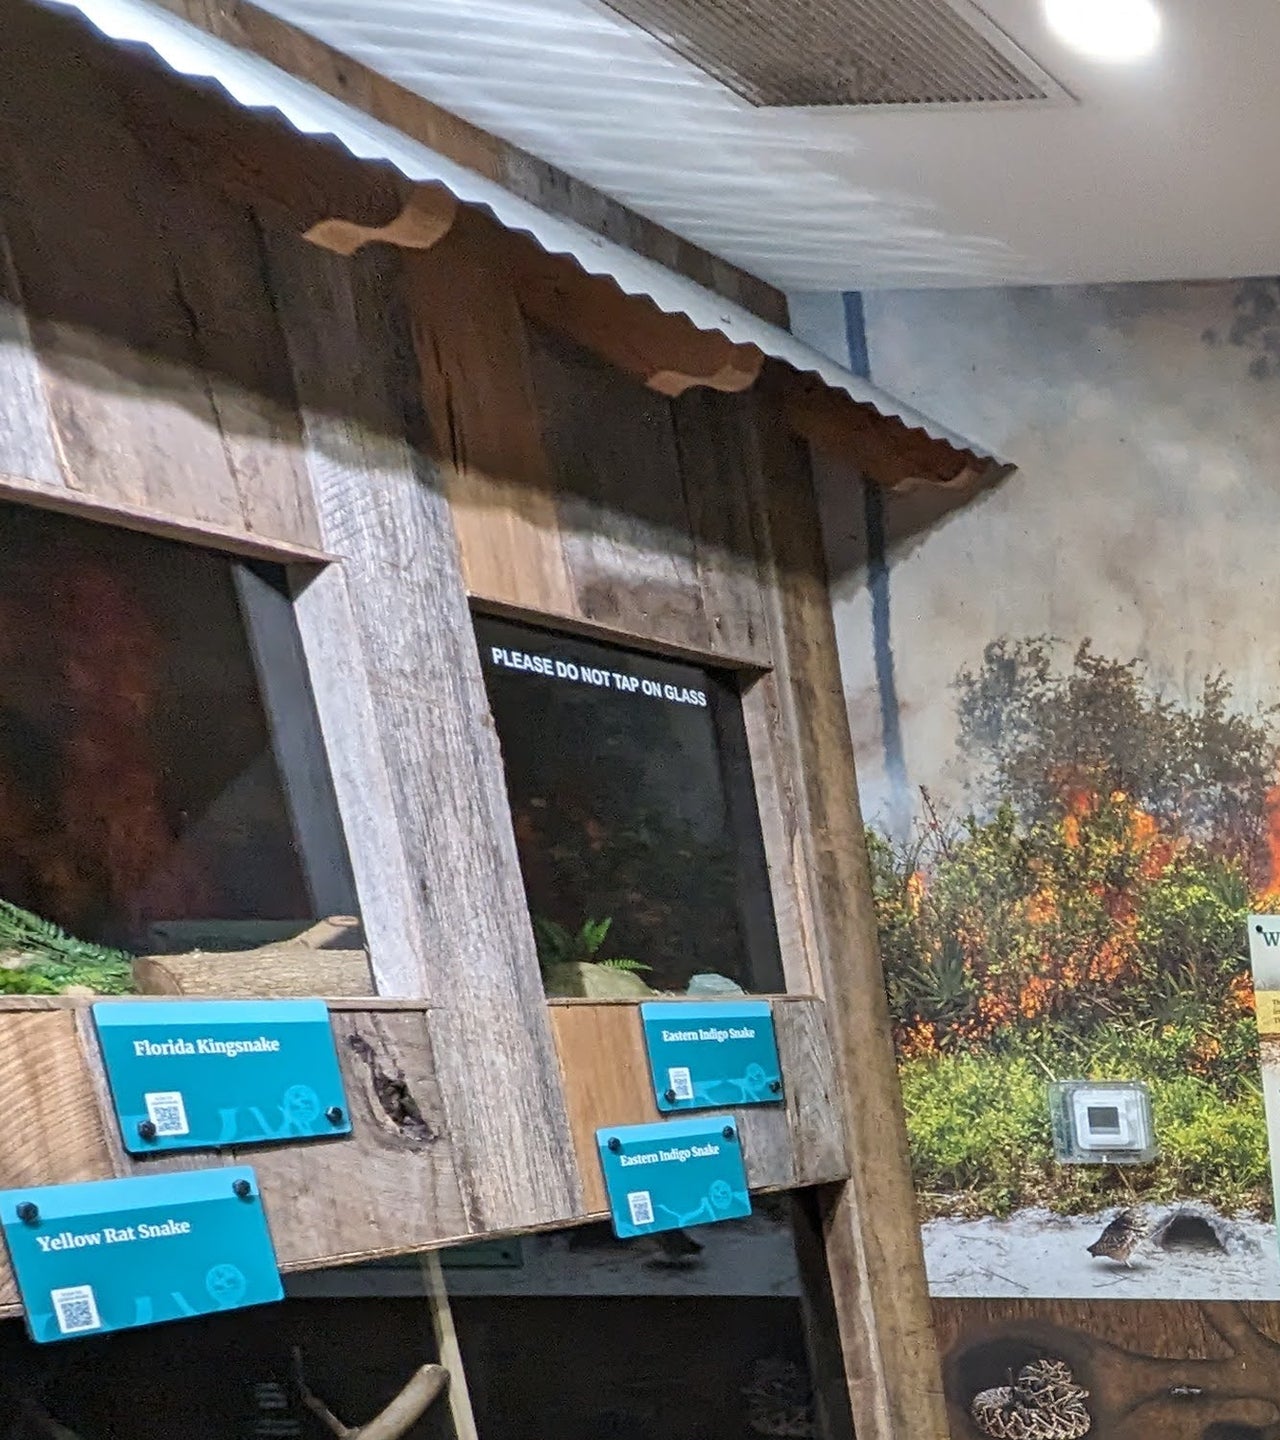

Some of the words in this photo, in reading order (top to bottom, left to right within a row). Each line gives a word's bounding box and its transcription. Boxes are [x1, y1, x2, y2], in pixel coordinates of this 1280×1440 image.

[491, 647, 554, 675] PLEASE
[556, 661, 578, 680] DO
[582, 666, 610, 687] NOT
[613, 673, 639, 693] TAP
[642, 680, 662, 698] ON
[664, 685, 707, 707] GLASS
[662, 1030, 698, 1042] Eastern
[698, 1028, 728, 1043] Indigo
[729, 1027, 755, 1038] Snake
[133, 1039, 195, 1056] Florida
[196, 1037, 280, 1057] Kingsnake
[621, 1154, 658, 1166] Eastern
[659, 1148, 691, 1162] Indigo
[691, 1143, 719, 1157] Snake
[36, 1232, 100, 1251] Yellow
[104, 1227, 136, 1243] Rat
[137, 1219, 191, 1239] Snake
